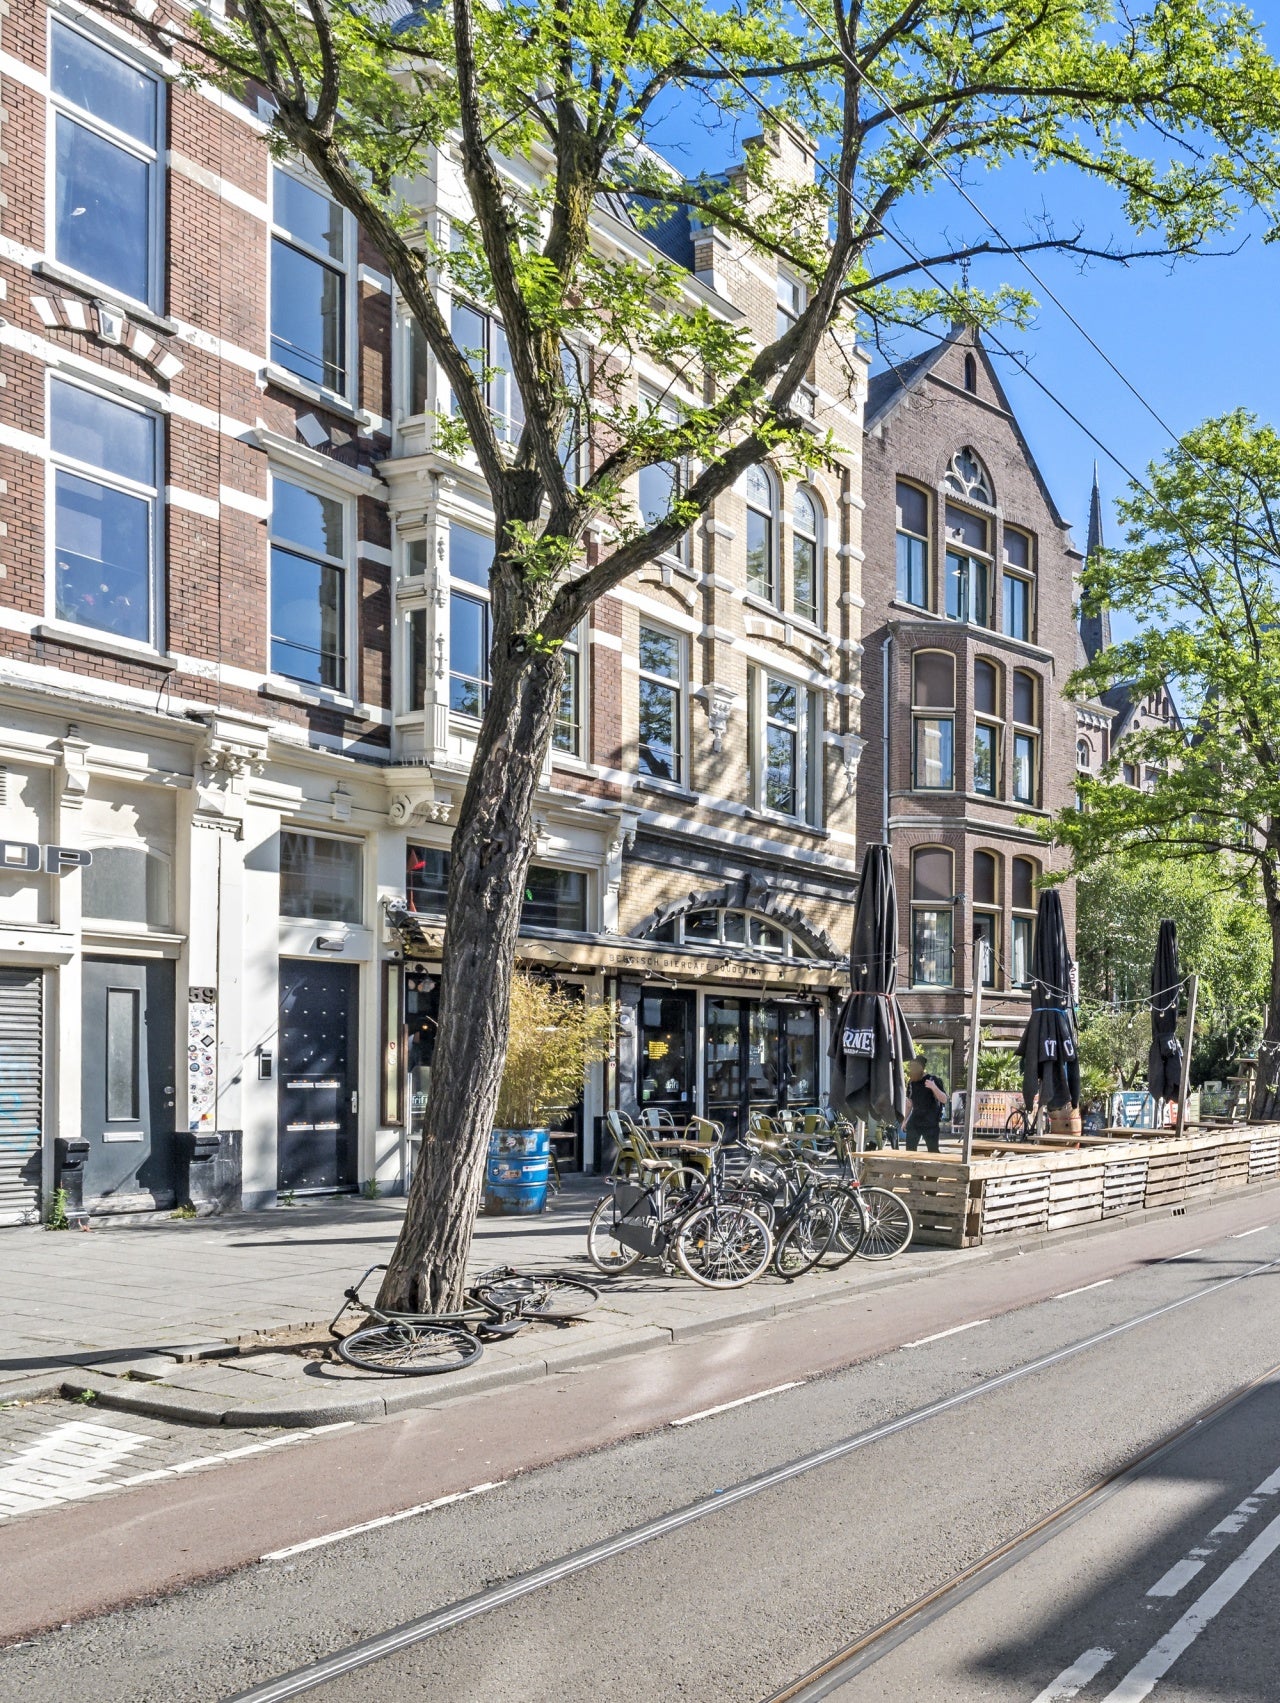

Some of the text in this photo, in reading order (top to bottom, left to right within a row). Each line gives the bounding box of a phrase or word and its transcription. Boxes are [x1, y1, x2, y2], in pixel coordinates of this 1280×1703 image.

[0, 839, 92, 875] OP
[609, 954, 659, 967] BEGISCH
[714, 964, 761, 976] BOUDEWIN
[188, 987, 216, 1004] 59
[842, 1030, 873, 1051] RNE
